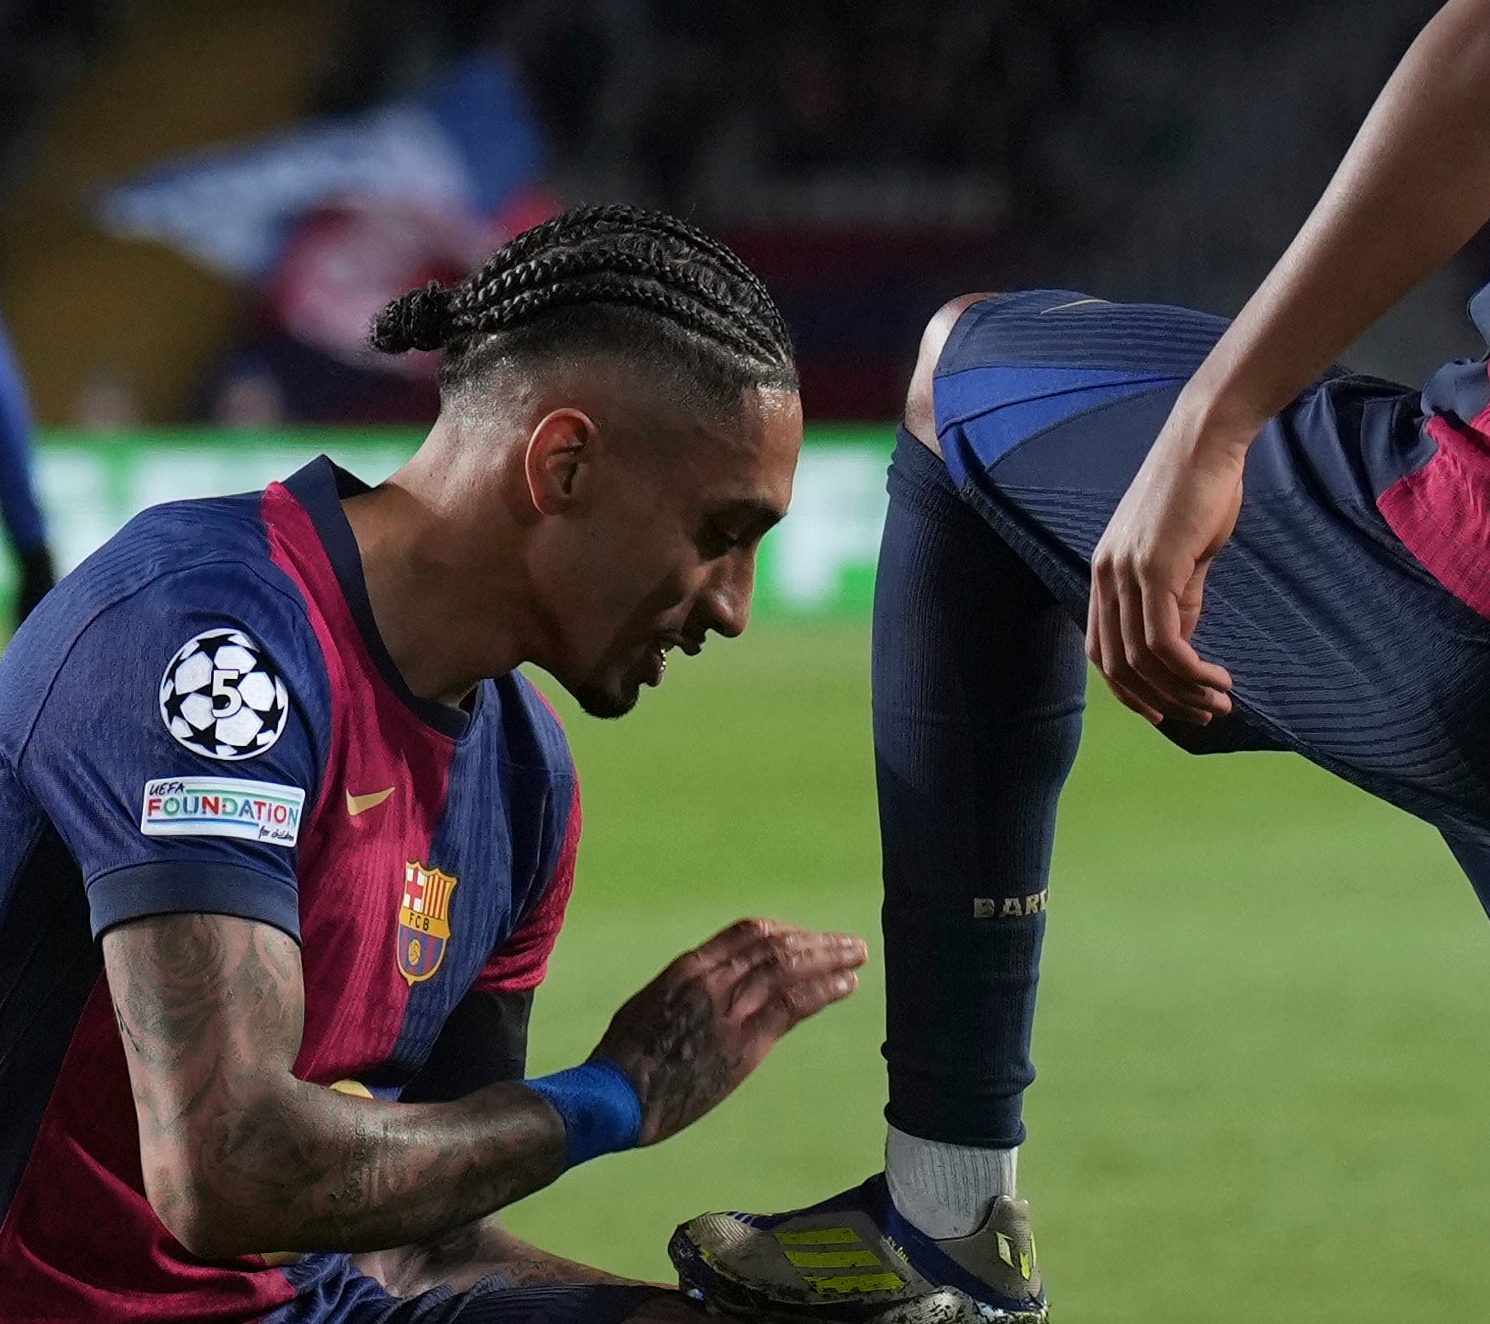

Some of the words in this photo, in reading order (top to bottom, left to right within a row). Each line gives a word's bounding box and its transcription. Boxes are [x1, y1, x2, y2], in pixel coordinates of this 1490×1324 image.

[210, 668, 243, 719] 5
[148, 781, 186, 797] UEFA
[147, 795, 299, 826] FOUNDATION
